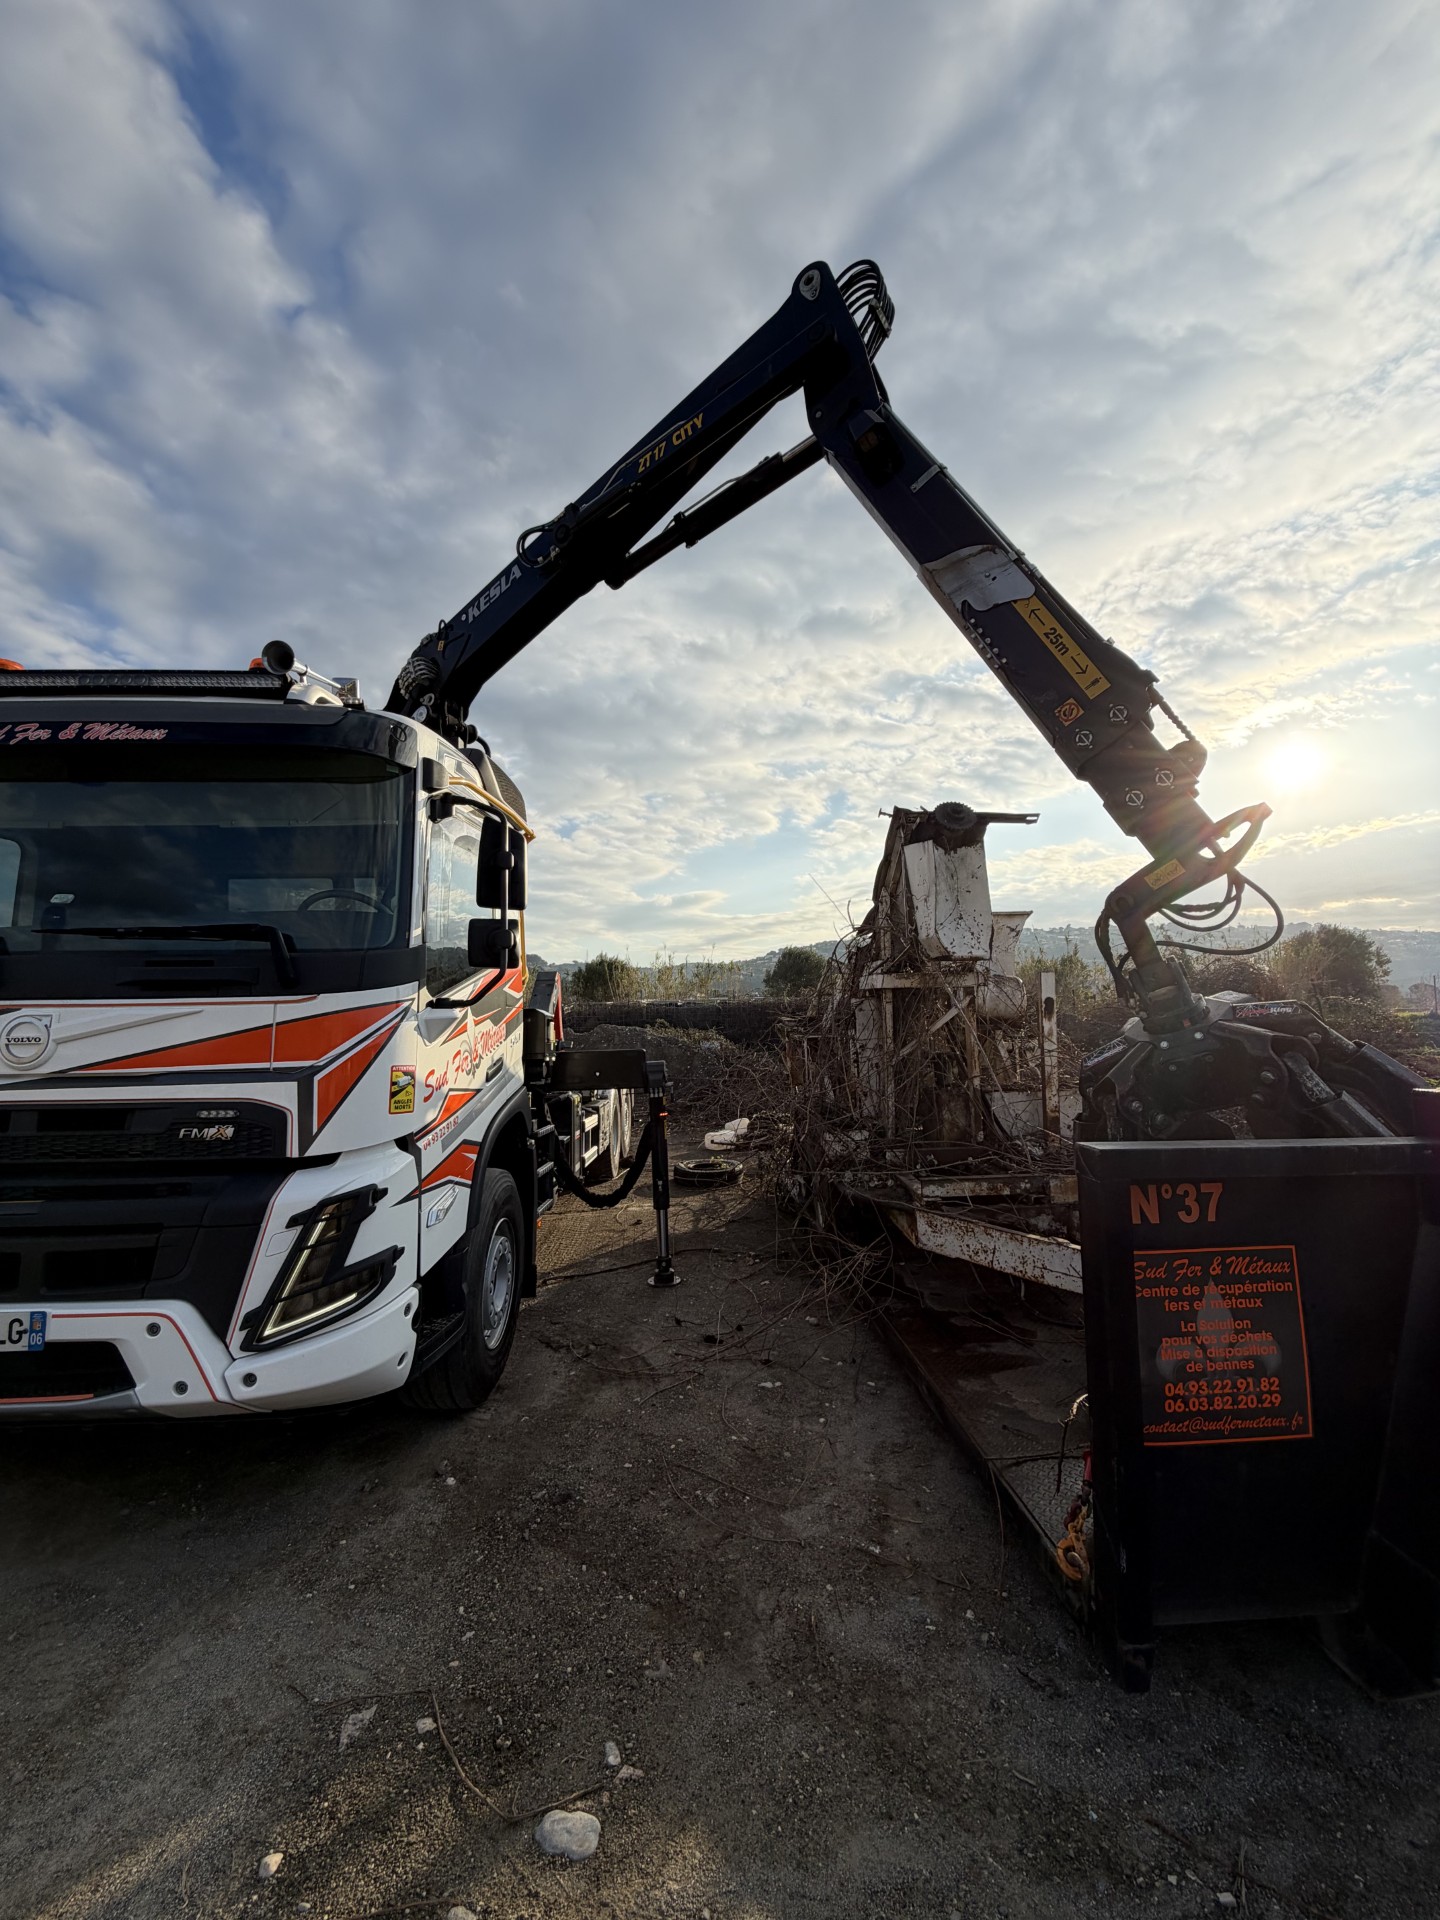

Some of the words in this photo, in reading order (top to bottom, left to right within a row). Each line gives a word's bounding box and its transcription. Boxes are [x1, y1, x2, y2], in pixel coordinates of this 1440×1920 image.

[638, 451, 652, 474] ZT
[653, 440, 667, 461] 17
[672, 412, 704, 446] CITY
[467, 563, 522, 624] KESLA
[1043, 626, 1070, 656] 25m
[10, 722, 52, 745] Fer
[58, 722, 82, 740] &
[423, 1059, 450, 1103] Sud
[178, 1124, 235, 1141] FMX
[431, 1131, 439, 1145] 93
[1129, 1182, 1223, 1225] N°37
[1134, 1261, 1168, 1280] Sud
[1172, 1258, 1203, 1282] Fer
[1209, 1256, 1223, 1276] &
[1225, 1255, 1291, 1276] Métaux
[1182, 1284, 1201, 1295] de
[1203, 1279, 1293, 1297] récupération
[1164, 1301, 1190, 1312] fers
[1210, 1296, 1264, 1310] métaux
[0, 1317, 28, 1345] G
[1180, 1320, 1197, 1333] La
[1200, 1318, 1252, 1332] Solution
[30, 1332, 43, 1345] 06
[1162, 1335, 1193, 1349] pour
[1195, 1334, 1217, 1345] vos
[1221, 1330, 1273, 1344] déchets
[1160, 1348, 1191, 1361] Mise
[1194, 1346, 1203, 1358] à
[1206, 1344, 1278, 1359] disposition
[1186, 1361, 1204, 1373] de
[1206, 1359, 1255, 1372] bennes
[1164, 1377, 1280, 1397] 04.93.22.91.82
[1164, 1393, 1282, 1413] 06.03.82.20.29
